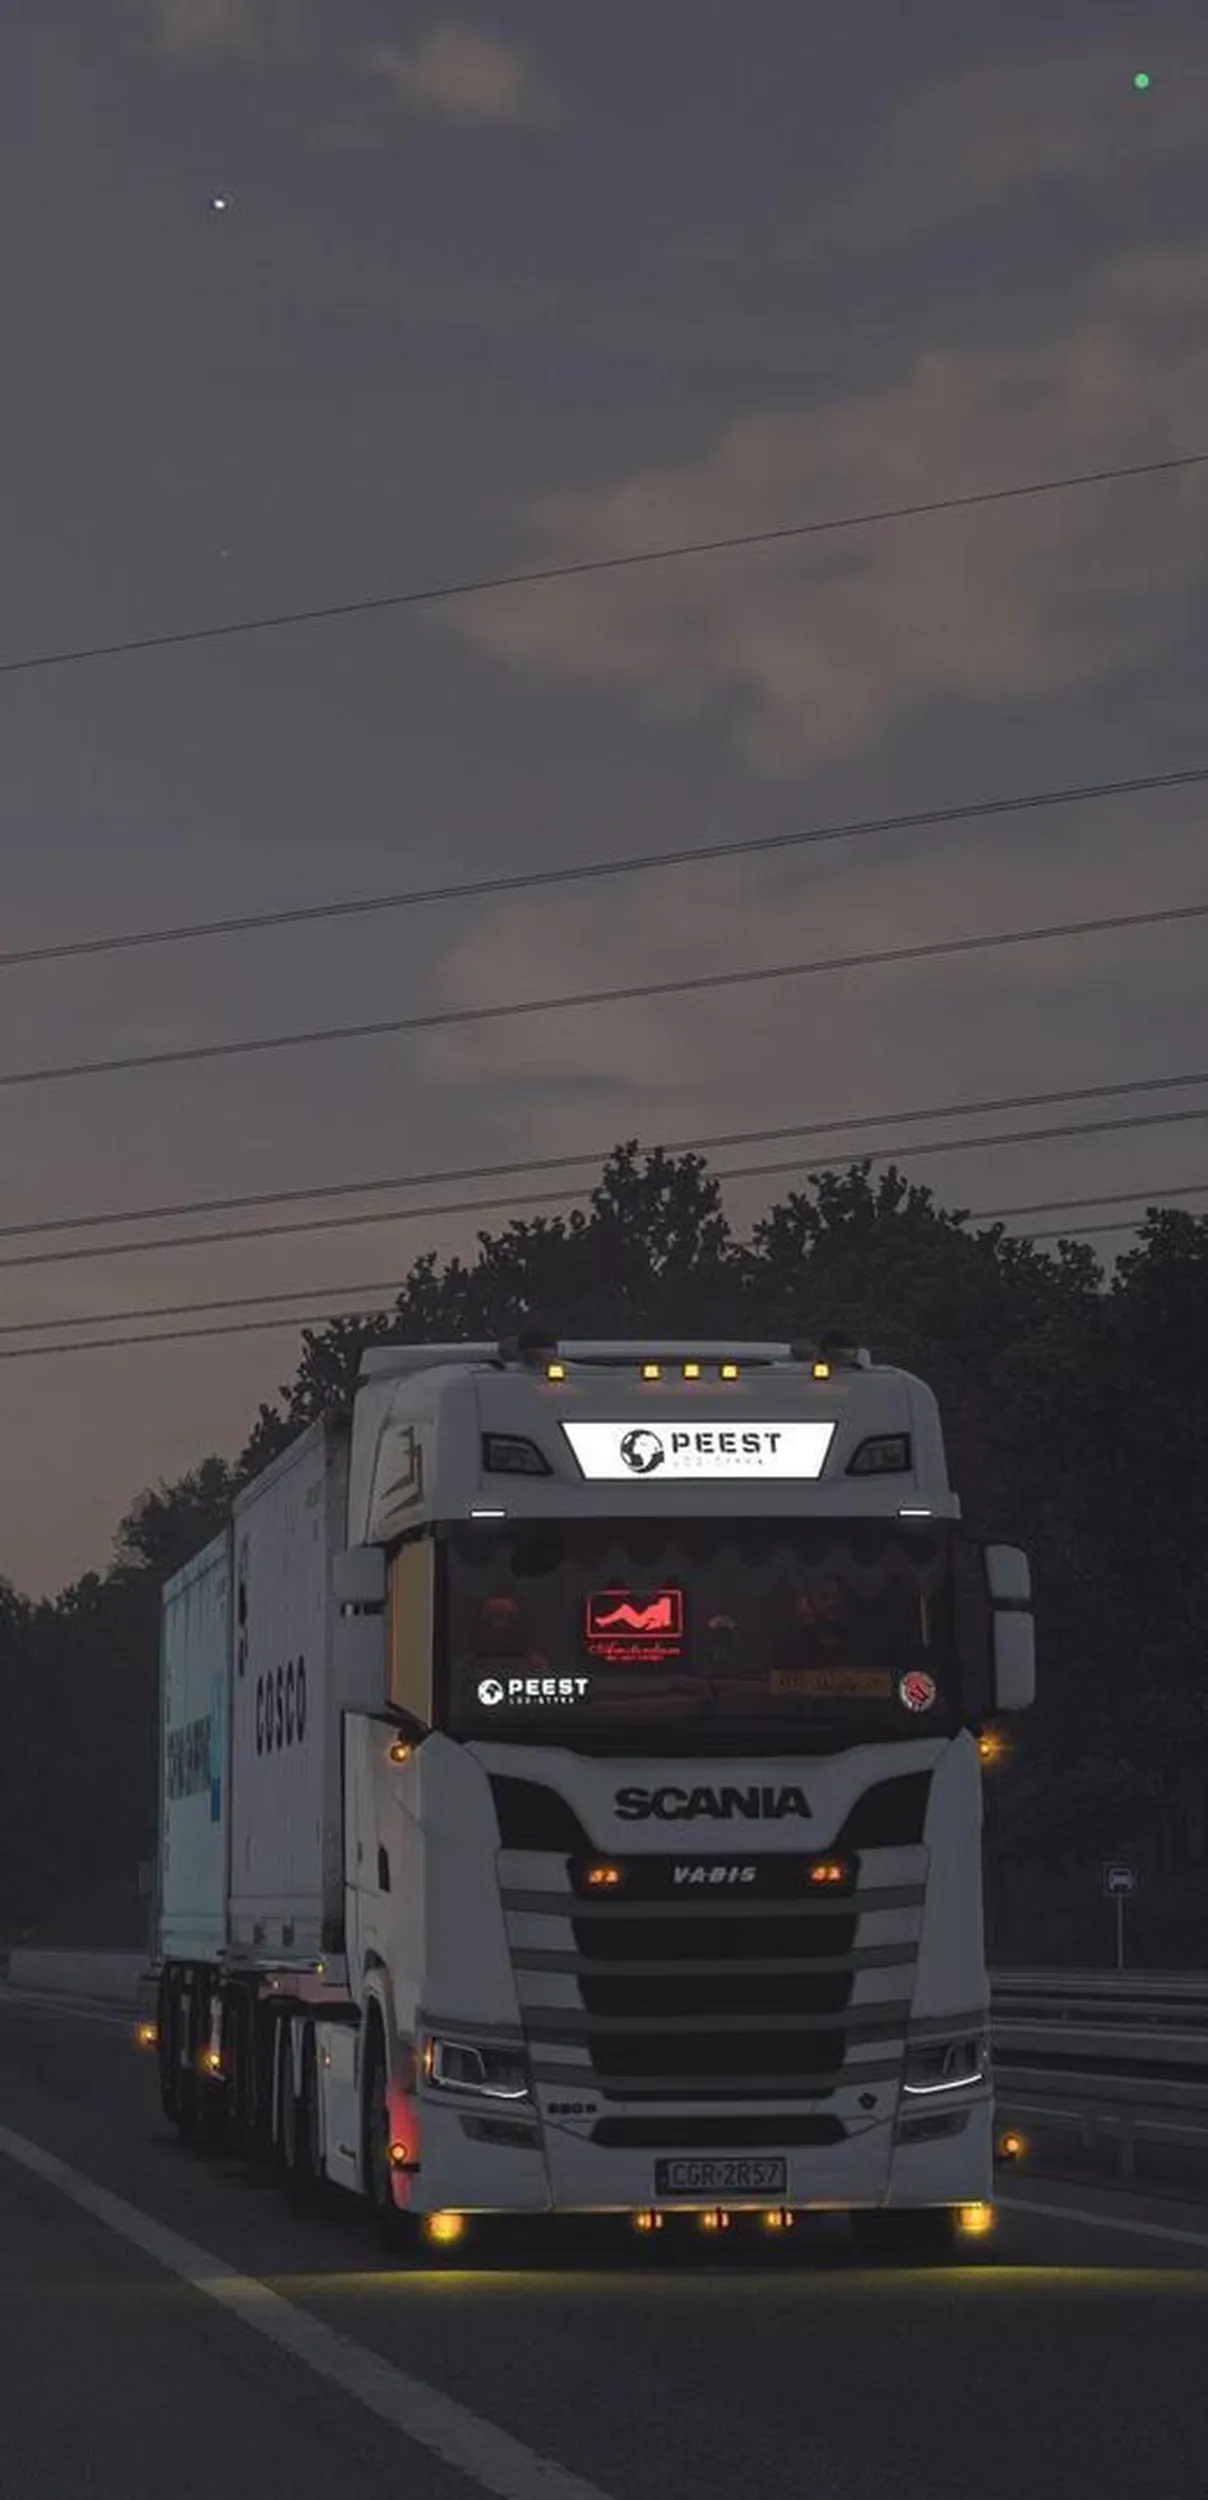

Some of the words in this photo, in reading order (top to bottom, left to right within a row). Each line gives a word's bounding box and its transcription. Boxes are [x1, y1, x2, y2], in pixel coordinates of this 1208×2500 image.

[671, 1432, 781, 1453] PEEST
[508, 1678, 590, 1696] PEEST
[256, 1655, 306, 1756] COSCO
[614, 1786, 813, 1820] SCANIA
[673, 1865, 758, 1885] VABIS
[672, 2163, 716, 2186] CGR
